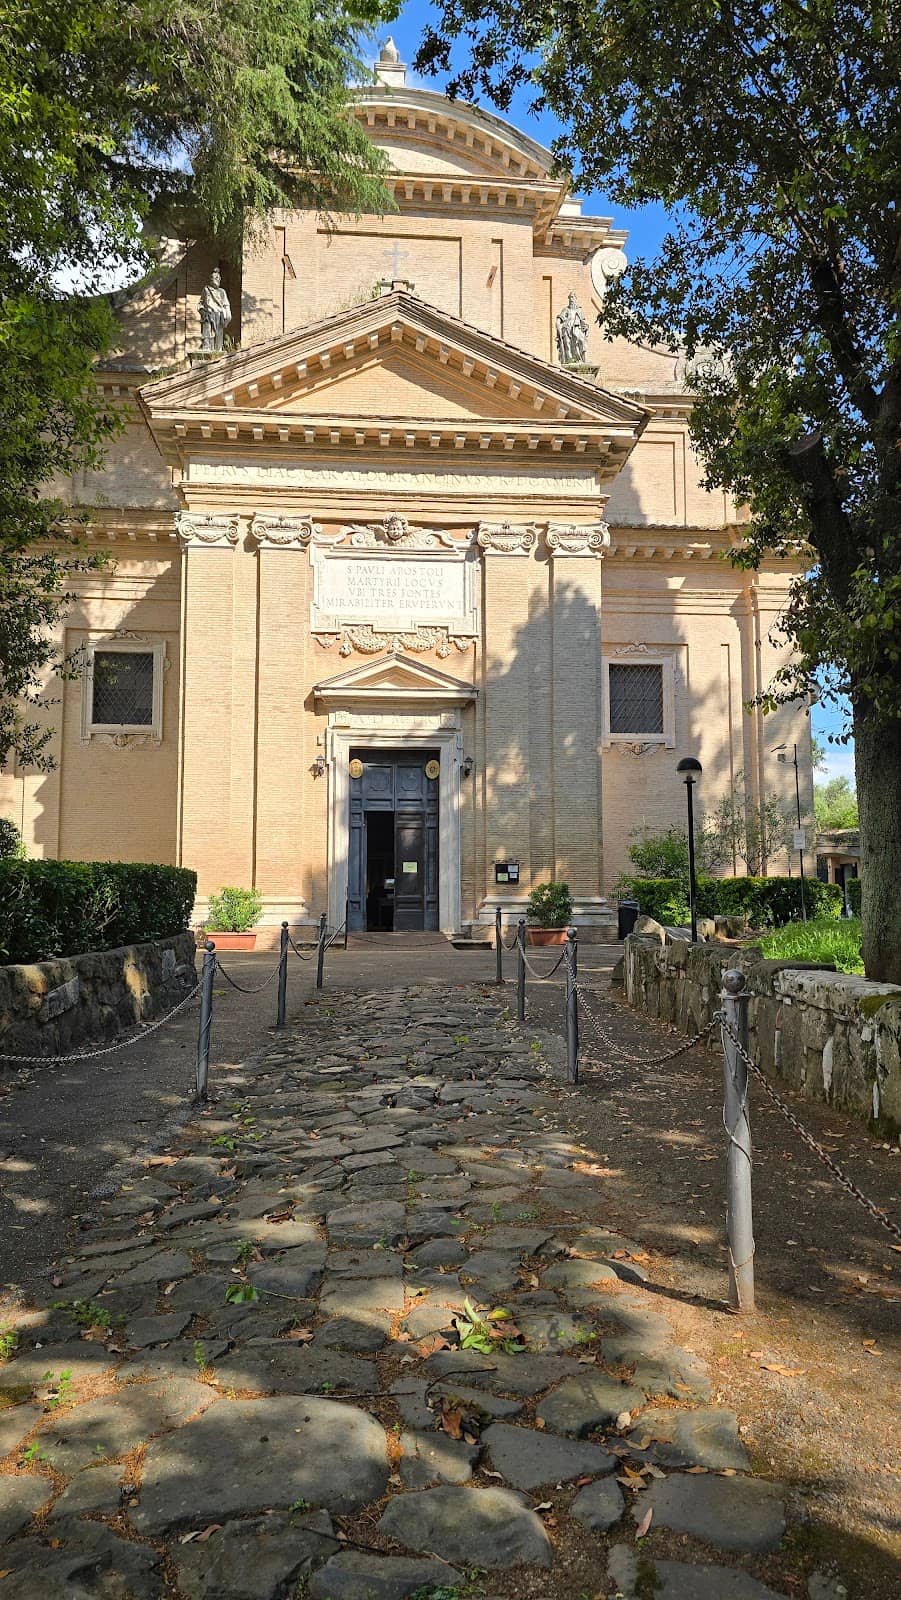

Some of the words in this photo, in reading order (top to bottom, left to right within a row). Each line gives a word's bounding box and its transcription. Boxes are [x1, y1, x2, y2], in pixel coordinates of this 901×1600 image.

[356, 565, 385, 575] PAVLI
[390, 566, 444, 577] APOSTOLI
[405, 577, 445, 588] LOCVS
[371, 588, 397, 598] TRES
[401, 588, 441, 599] FONTES
